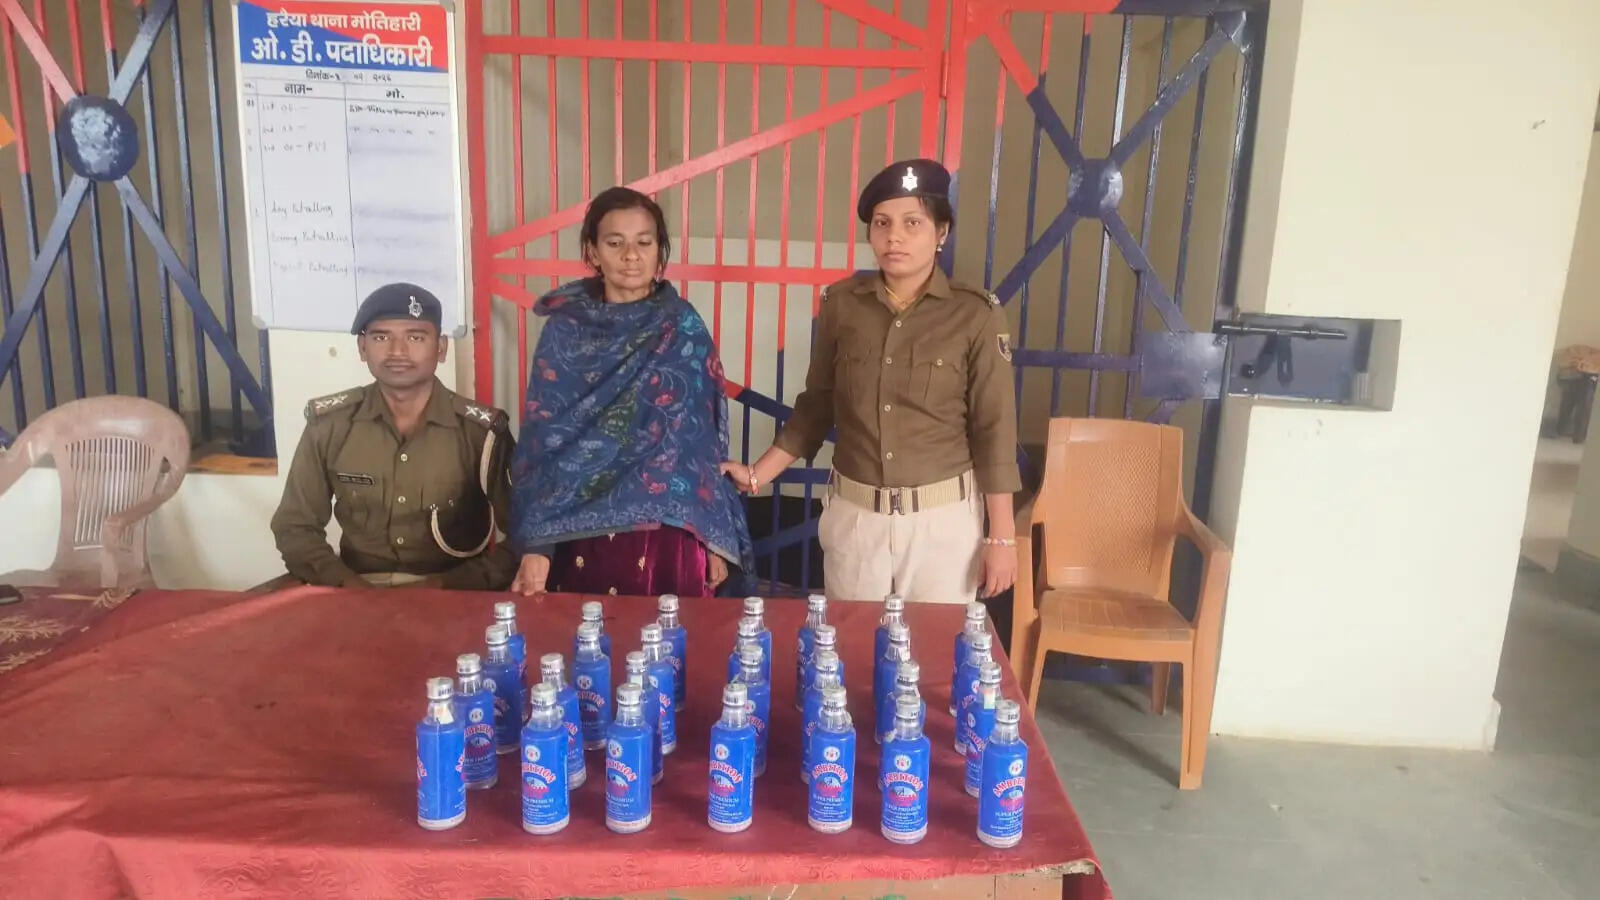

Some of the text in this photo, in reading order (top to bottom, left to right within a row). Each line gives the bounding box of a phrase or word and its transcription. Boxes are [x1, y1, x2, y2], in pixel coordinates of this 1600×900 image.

[310, 13, 348, 29] थाना
[350, 10, 421, 33] मोतिहारी
[250, 30, 432, 67] ओ. डी. पदाधिकारी
